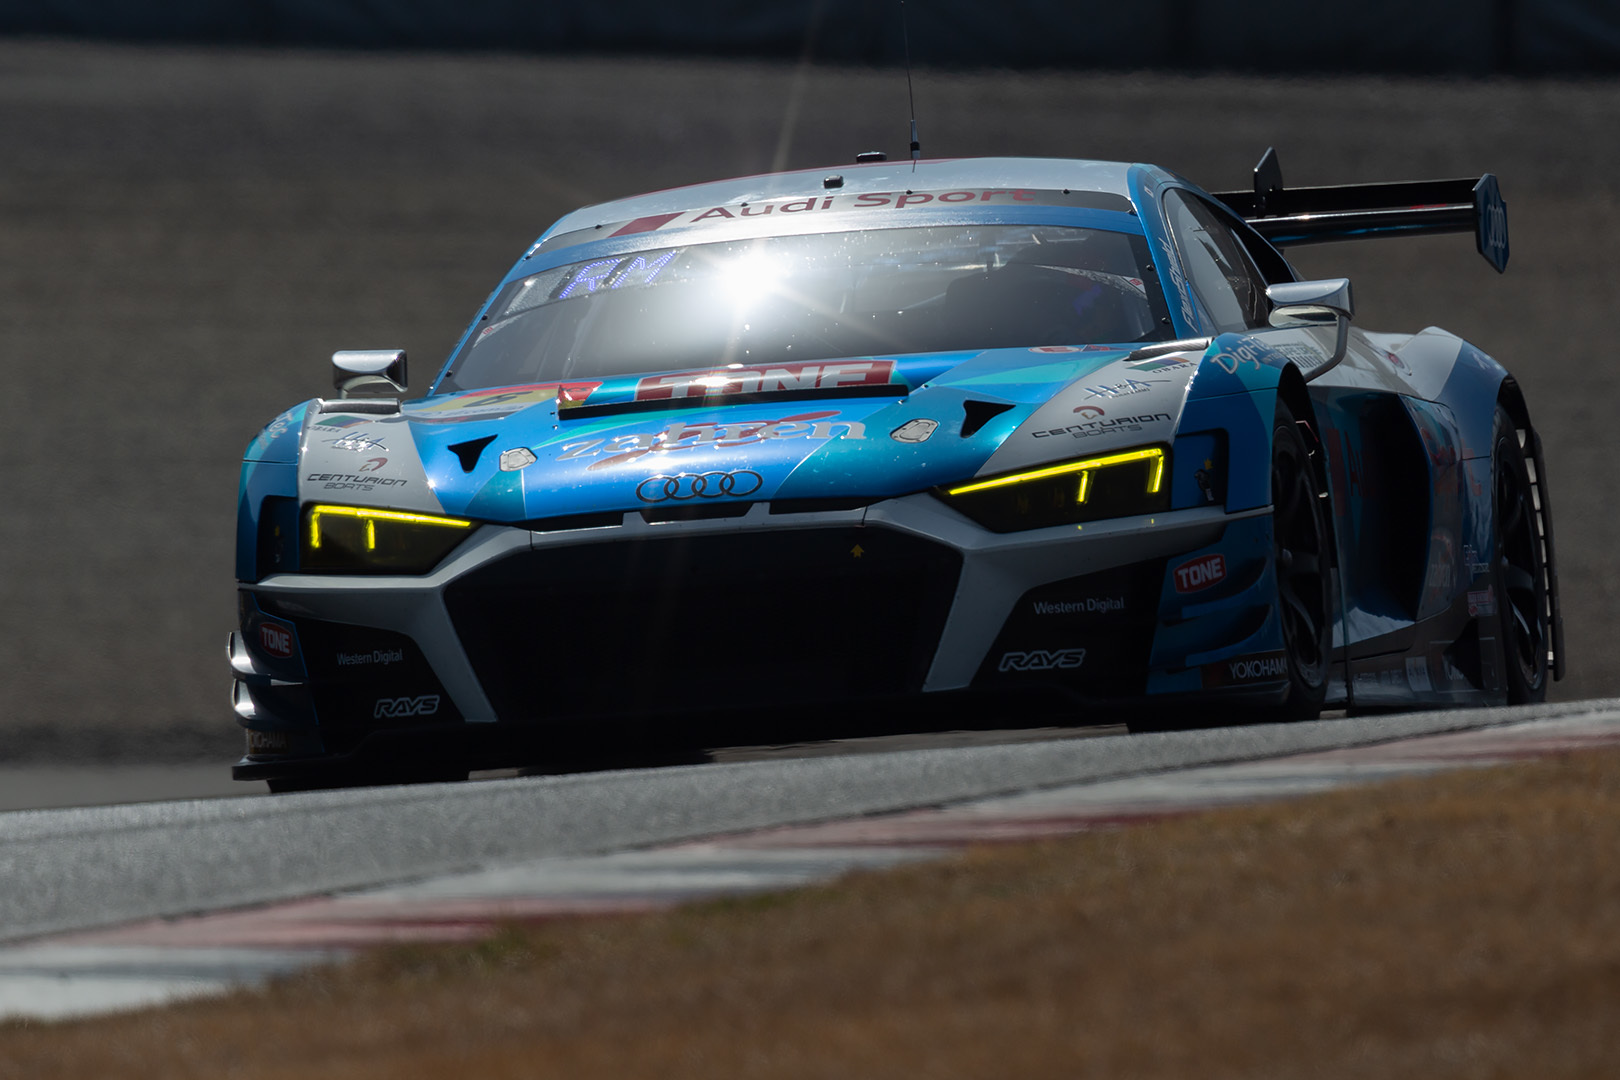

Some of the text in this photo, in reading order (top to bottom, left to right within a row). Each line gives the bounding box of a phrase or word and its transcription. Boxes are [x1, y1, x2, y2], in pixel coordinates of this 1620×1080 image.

[690, 188, 1036, 223] Audi Sport
[1152, 362, 1198, 374] OBARA
[1032, 413, 1173, 438] CENTURION
[1071, 424, 1144, 439] BOATS
[307, 473, 408, 487] CENTURION
[323, 482, 376, 492] BOATS
[1177, 557, 1223, 589] TONE
[1033, 597, 1124, 615] Western Digital
[262, 626, 291, 654] TONE
[336, 649, 403, 666] Western Digital
[999, 648, 1087, 671] RAYS
[373, 695, 441, 719] RAYS
